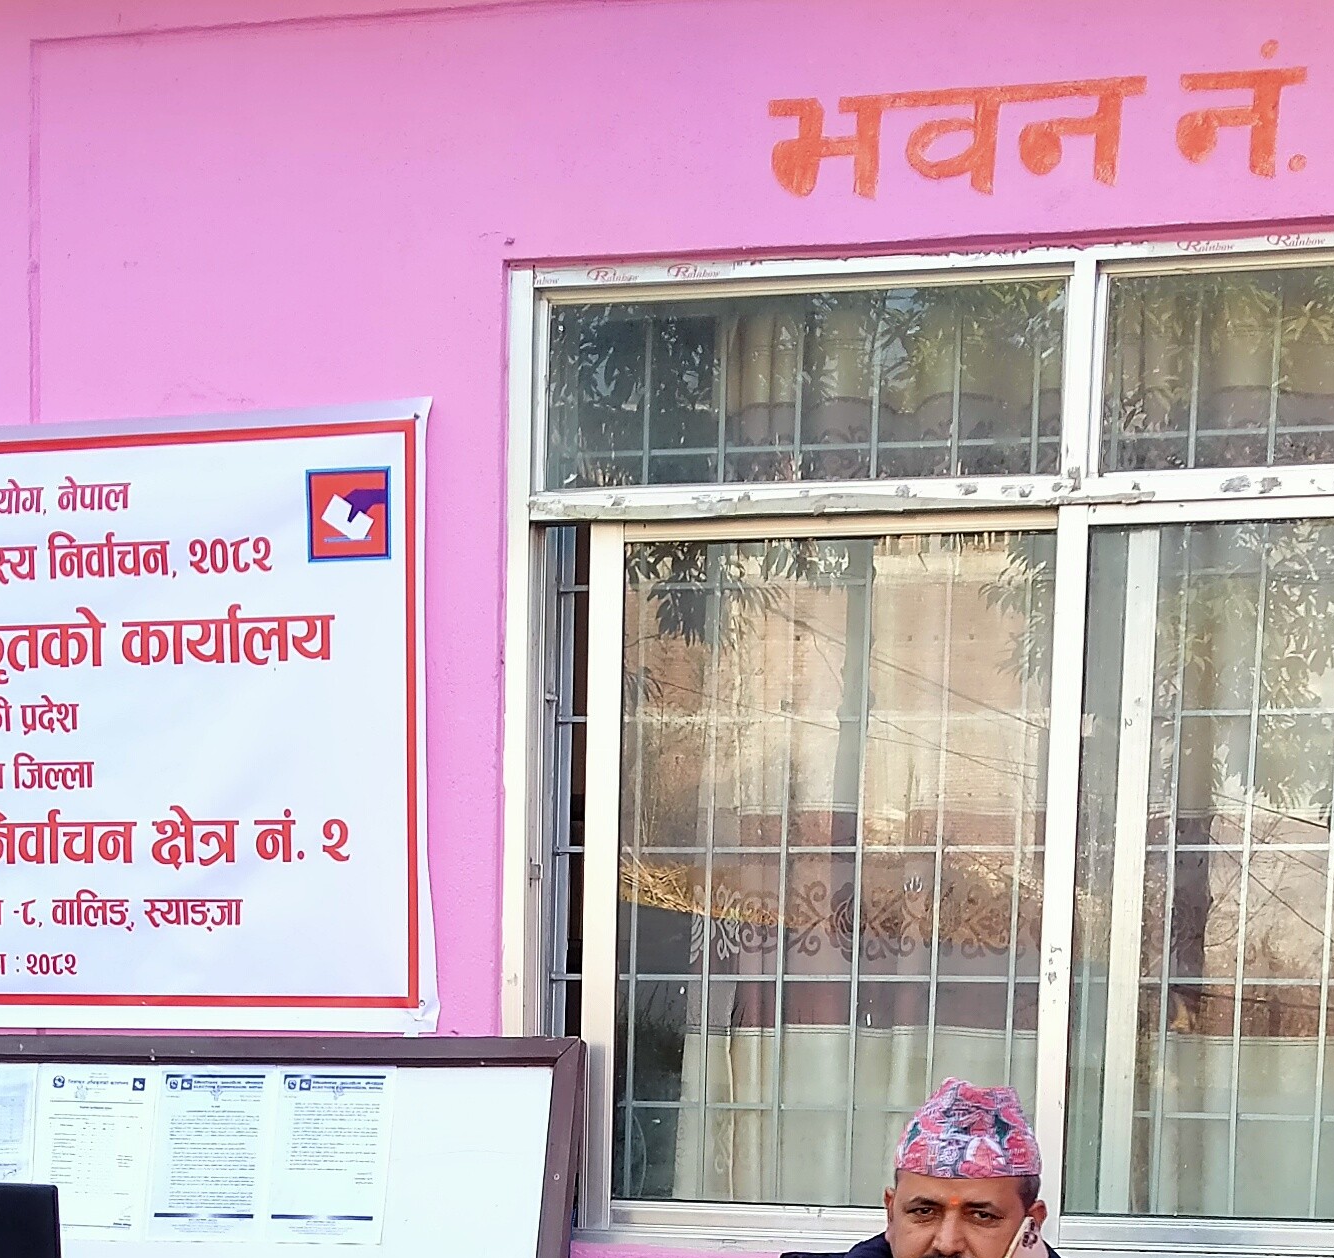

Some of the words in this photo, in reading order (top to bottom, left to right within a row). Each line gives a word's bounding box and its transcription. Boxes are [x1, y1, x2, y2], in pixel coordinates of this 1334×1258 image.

[768, 76, 1147, 200] भवन
[1176, 39, 1308, 178] नं.
[667, 263, 721, 280] Rainbow
[1177, 239, 1234, 253] Rainbow
[1267, 233, 1325, 247] Rainbow
[58, 475, 131, 513] नेपाल
[47, 531, 177, 582] निर्वाचन,
[188, 536, 272, 575] २०८२
[121, 603, 336, 667] कार्यालय
[20, 695, 79, 736] प्रदेश
[13, 751, 95, 791] जिल्ला
[151, 804, 239, 870] क्षेत्र
[254, 808, 306, 863] नं.
[321, 818, 351, 863] २
[26, 953, 78, 977] २०८२
